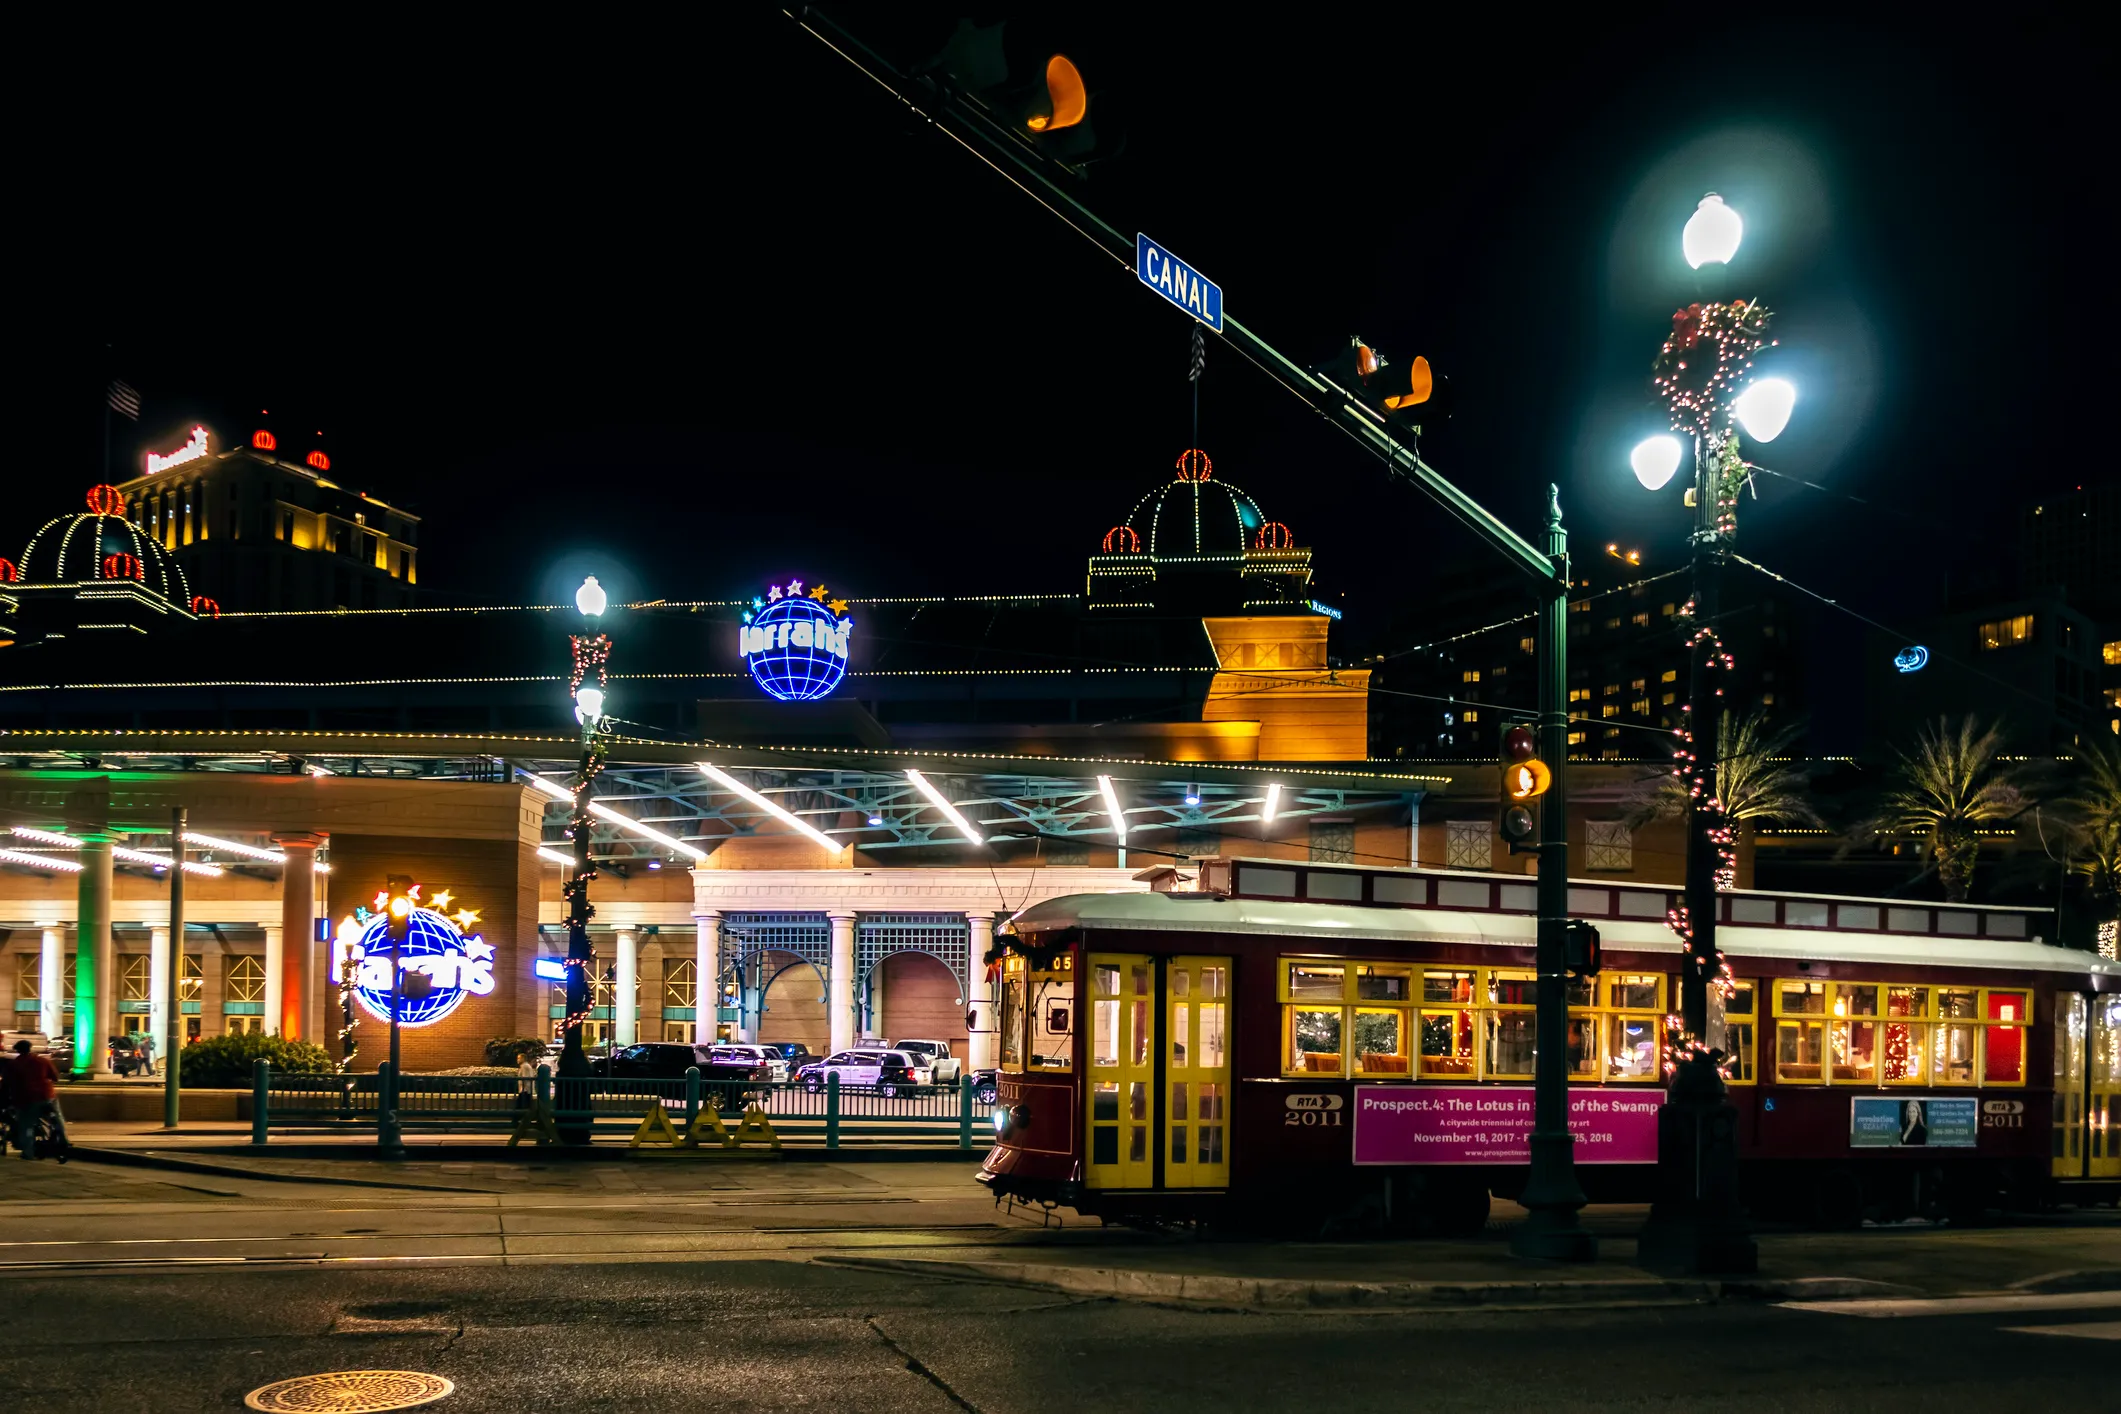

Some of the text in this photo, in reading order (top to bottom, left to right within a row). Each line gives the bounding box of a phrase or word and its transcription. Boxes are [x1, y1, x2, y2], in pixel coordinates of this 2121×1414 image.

[1147, 247, 1214, 322] CANAL
[1312, 601, 1342, 620] REGIONS
[999, 1083, 1020, 1099] 2011
[1297, 1097, 1318, 1107] RTA
[1363, 1098, 1445, 1115] Prospect.4:
[1447, 1099, 1473, 1112] The
[1476, 1099, 1514, 1112] Lotus
[1517, 1099, 1530, 1112] in
[1571, 1099, 1586, 1113] of
[1587, 1100, 1609, 1113] the
[1611, 1100, 1658, 1116] Swamp
[1991, 1103, 2006, 1111] RTA
[1284, 1111, 1342, 1126] 2011
[1440, 1119, 1446, 1127] A
[1446, 1119, 1480, 1128] citywide
[1480, 1119, 1515, 1127] triennial
[1515, 1119, 1524, 1127] of
[1983, 1115, 2024, 1128] 2011
[1414, 1133, 1473, 1143] November
[1474, 1133, 1489, 1145] 18,
[1491, 1133, 1515, 1143] 2017
[1574, 1133, 1588, 1145] 25,
[1590, 1133, 1613, 1143] 2018
[1465, 1150, 1533, 1158] www.prospectnewo
